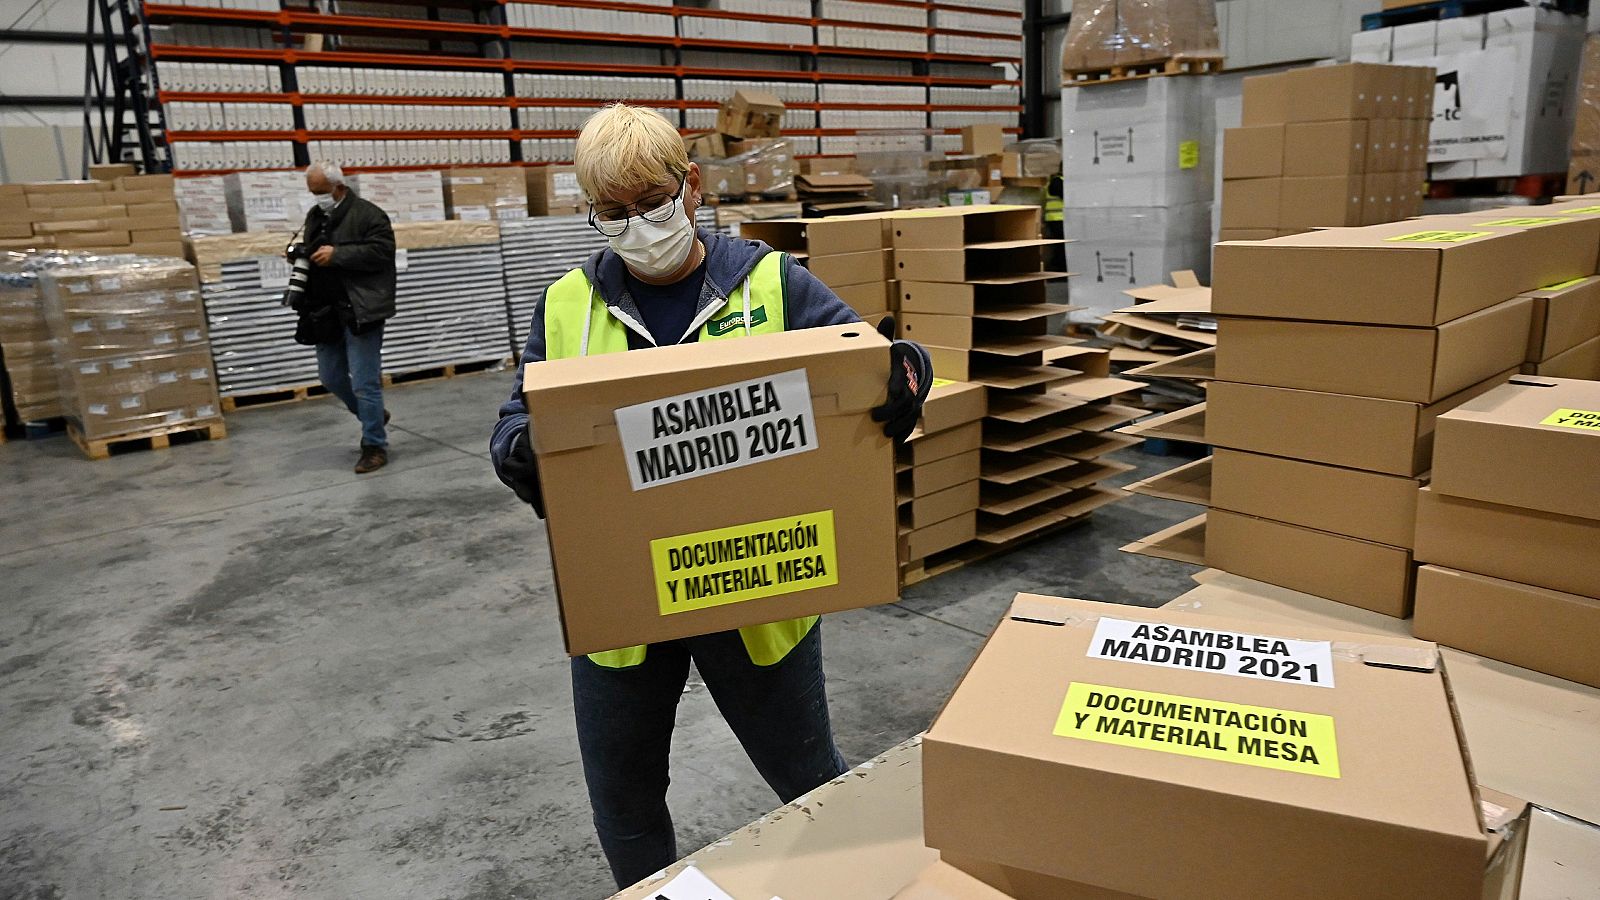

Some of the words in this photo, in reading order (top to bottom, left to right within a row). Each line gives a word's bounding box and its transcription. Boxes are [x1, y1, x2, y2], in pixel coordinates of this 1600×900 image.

[719, 315, 754, 329] Europcr
[651, 380, 782, 440] ASAMBLEA
[635, 430, 740, 484] MADRID
[745, 413, 808, 459] 2021
[668, 521, 819, 572] DOCUMENTACIÓN
[665, 579, 679, 603] Y
[684, 563, 773, 601] MATERIAL
[777, 554, 827, 585] MESA
[1100, 638, 1226, 670] MADRID
[1238, 655, 1319, 683] 2021
[1131, 624, 1291, 657] ASAMBLEA
[1074, 711, 1090, 730] Y
[1095, 715, 1227, 752] MATERIAL
[1237, 735, 1320, 765] MESA
[1086, 691, 1308, 738] DOCUMENTACIÓN
